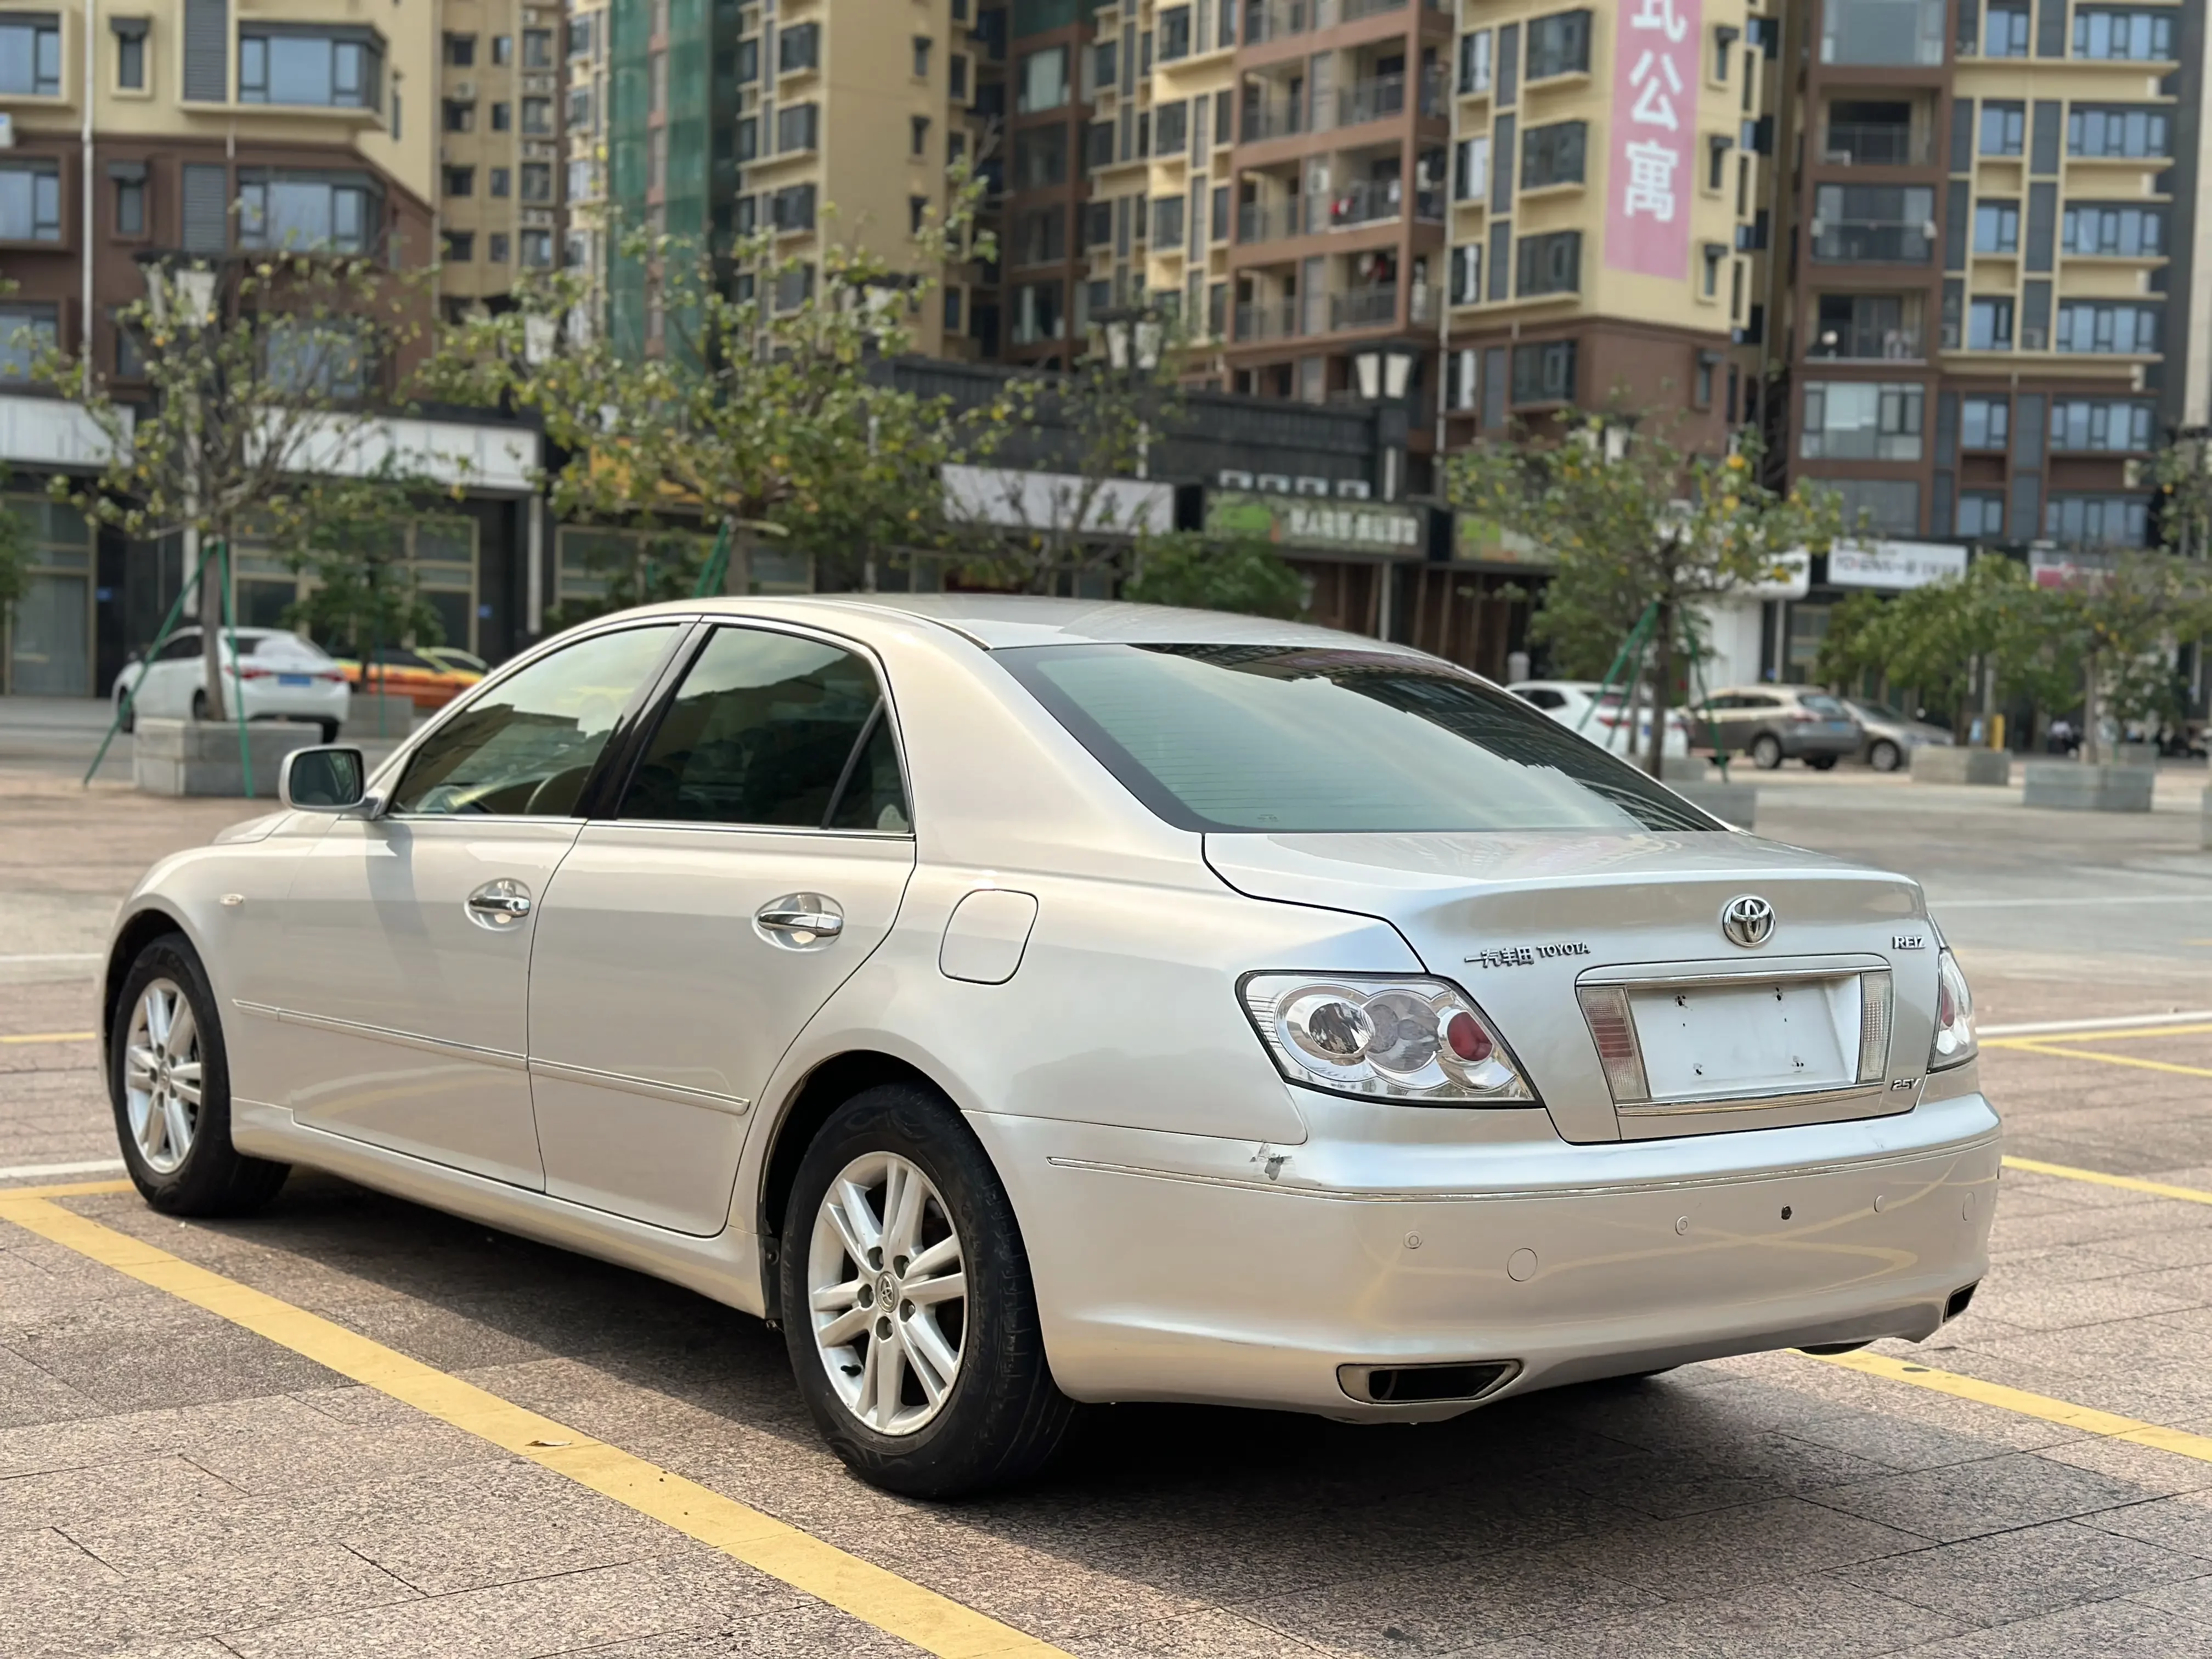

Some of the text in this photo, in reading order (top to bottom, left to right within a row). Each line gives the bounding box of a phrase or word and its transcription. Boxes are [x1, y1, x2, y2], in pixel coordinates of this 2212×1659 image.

[1892, 935, 1926, 950] REIZ
[1464, 942, 1591, 968] 一汽丰田 TOYOTA
